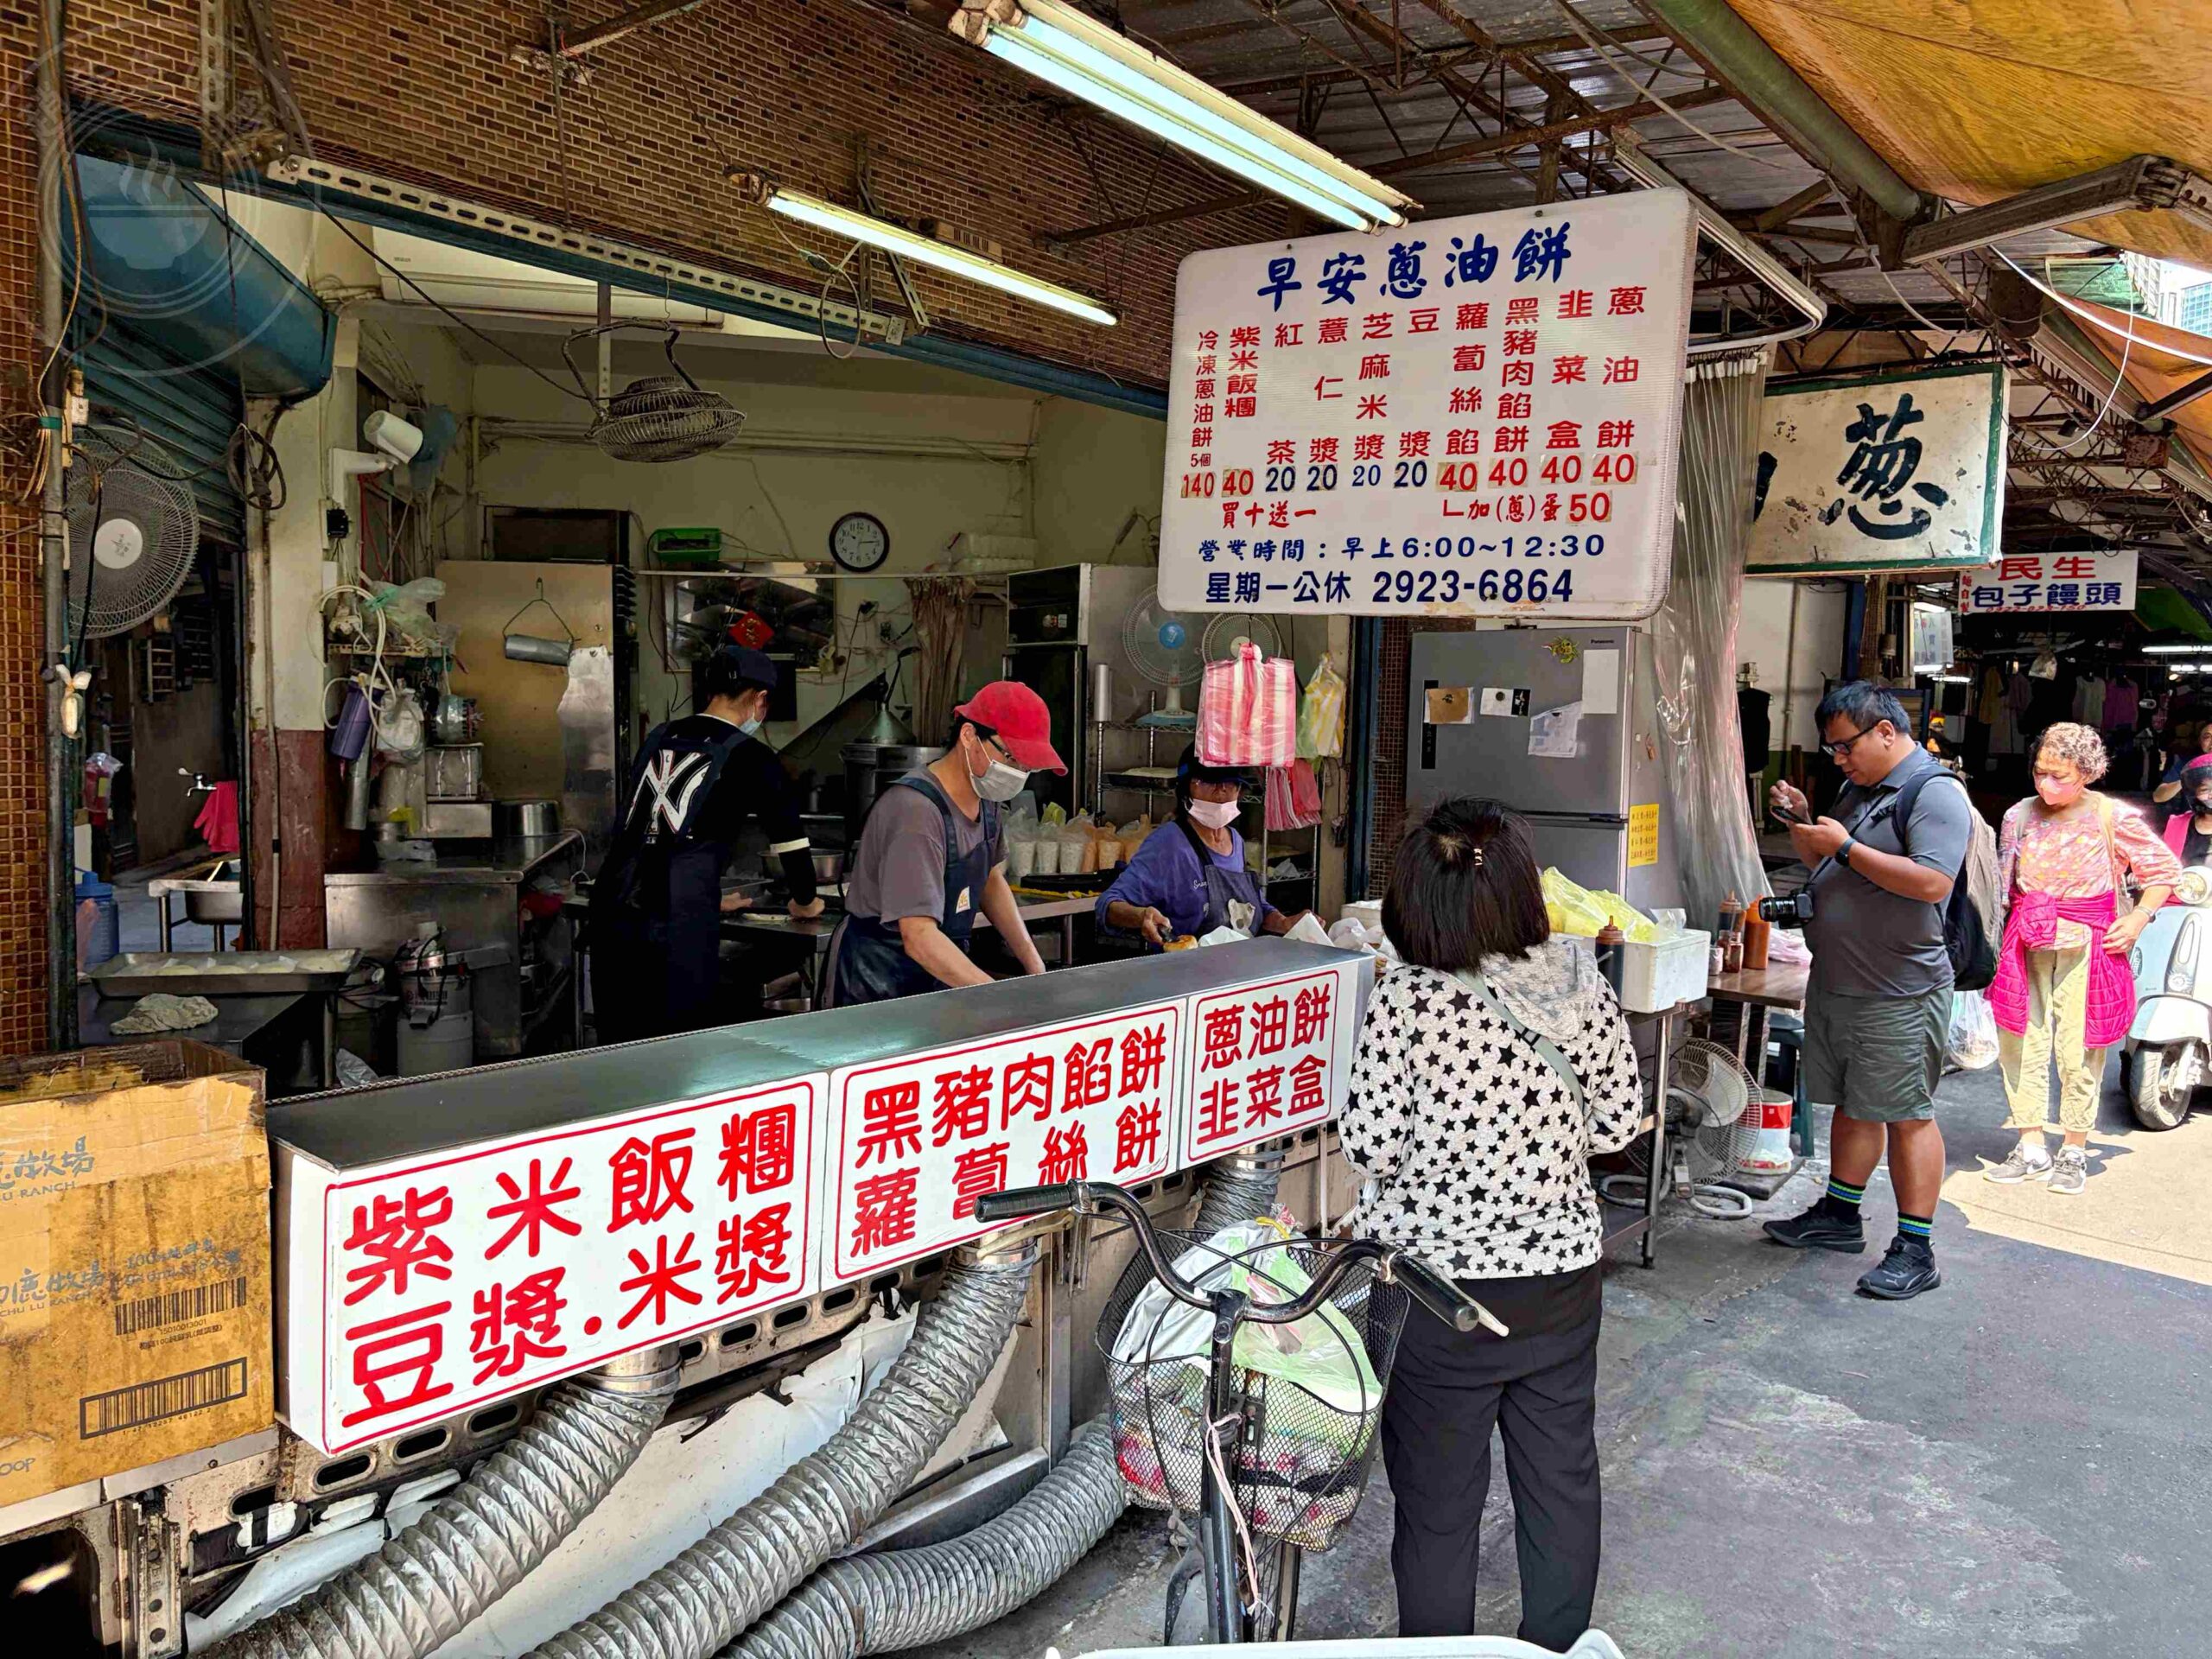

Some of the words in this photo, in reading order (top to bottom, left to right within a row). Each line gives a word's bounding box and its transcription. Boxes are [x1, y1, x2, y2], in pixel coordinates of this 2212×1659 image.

[1258, 222, 1571, 312] 早安蔥油餅
[1224, 326, 1261, 418] 紫米飯糰
[1398, 307, 1440, 457] 豆漿
[1446, 302, 1489, 455] 蘿蔔絲餡
[1492, 296, 1539, 454] 黑豬肉餡餅
[1545, 290, 1594, 450] 韭菜盒
[1596, 286, 1648, 448] 蔥油餅
[1191, 330, 1218, 448] 冷凍蔥油餅
[1267, 323, 1304, 465] 紅茶
[1308, 317, 1349, 462] 薏仁漿
[1353, 312, 1394, 461] 芝麻米漿
[1182, 472, 1215, 498] 140
[1222, 469, 1254, 496] 40
[1265, 467, 1296, 493] 20
[1306, 465, 1338, 491] 20
[1352, 465, 1381, 486] 20
[1394, 461, 1427, 488] 20
[1440, 462, 1478, 491] 40
[1488, 458, 1528, 486] 40
[1541, 454, 1582, 484] 40
[1592, 453, 1636, 484] 40
[1221, 500, 1318, 529] 買十送一
[1567, 492, 1611, 523] 50
[1205, 570, 1351, 603] 星期一公休
[1372, 568, 1574, 603] 2923-6864
[1998, 556, 2097, 581] 民生
[1970, 582, 2123, 608] 包子饅頭
[1200, 983, 1330, 1073] 蔥油餅
[854, 1022, 1166, 1169] 黑豬肉餡餅
[1197, 1054, 1326, 1146] 韭菜盒
[20, 1180, 76, 1198] RANCH
[850, 1096, 1162, 1258] 蘿蔔絲餅
[343, 1103, 797, 1306] 紫米飯糰
[29, 1302, 45, 1313] LU
